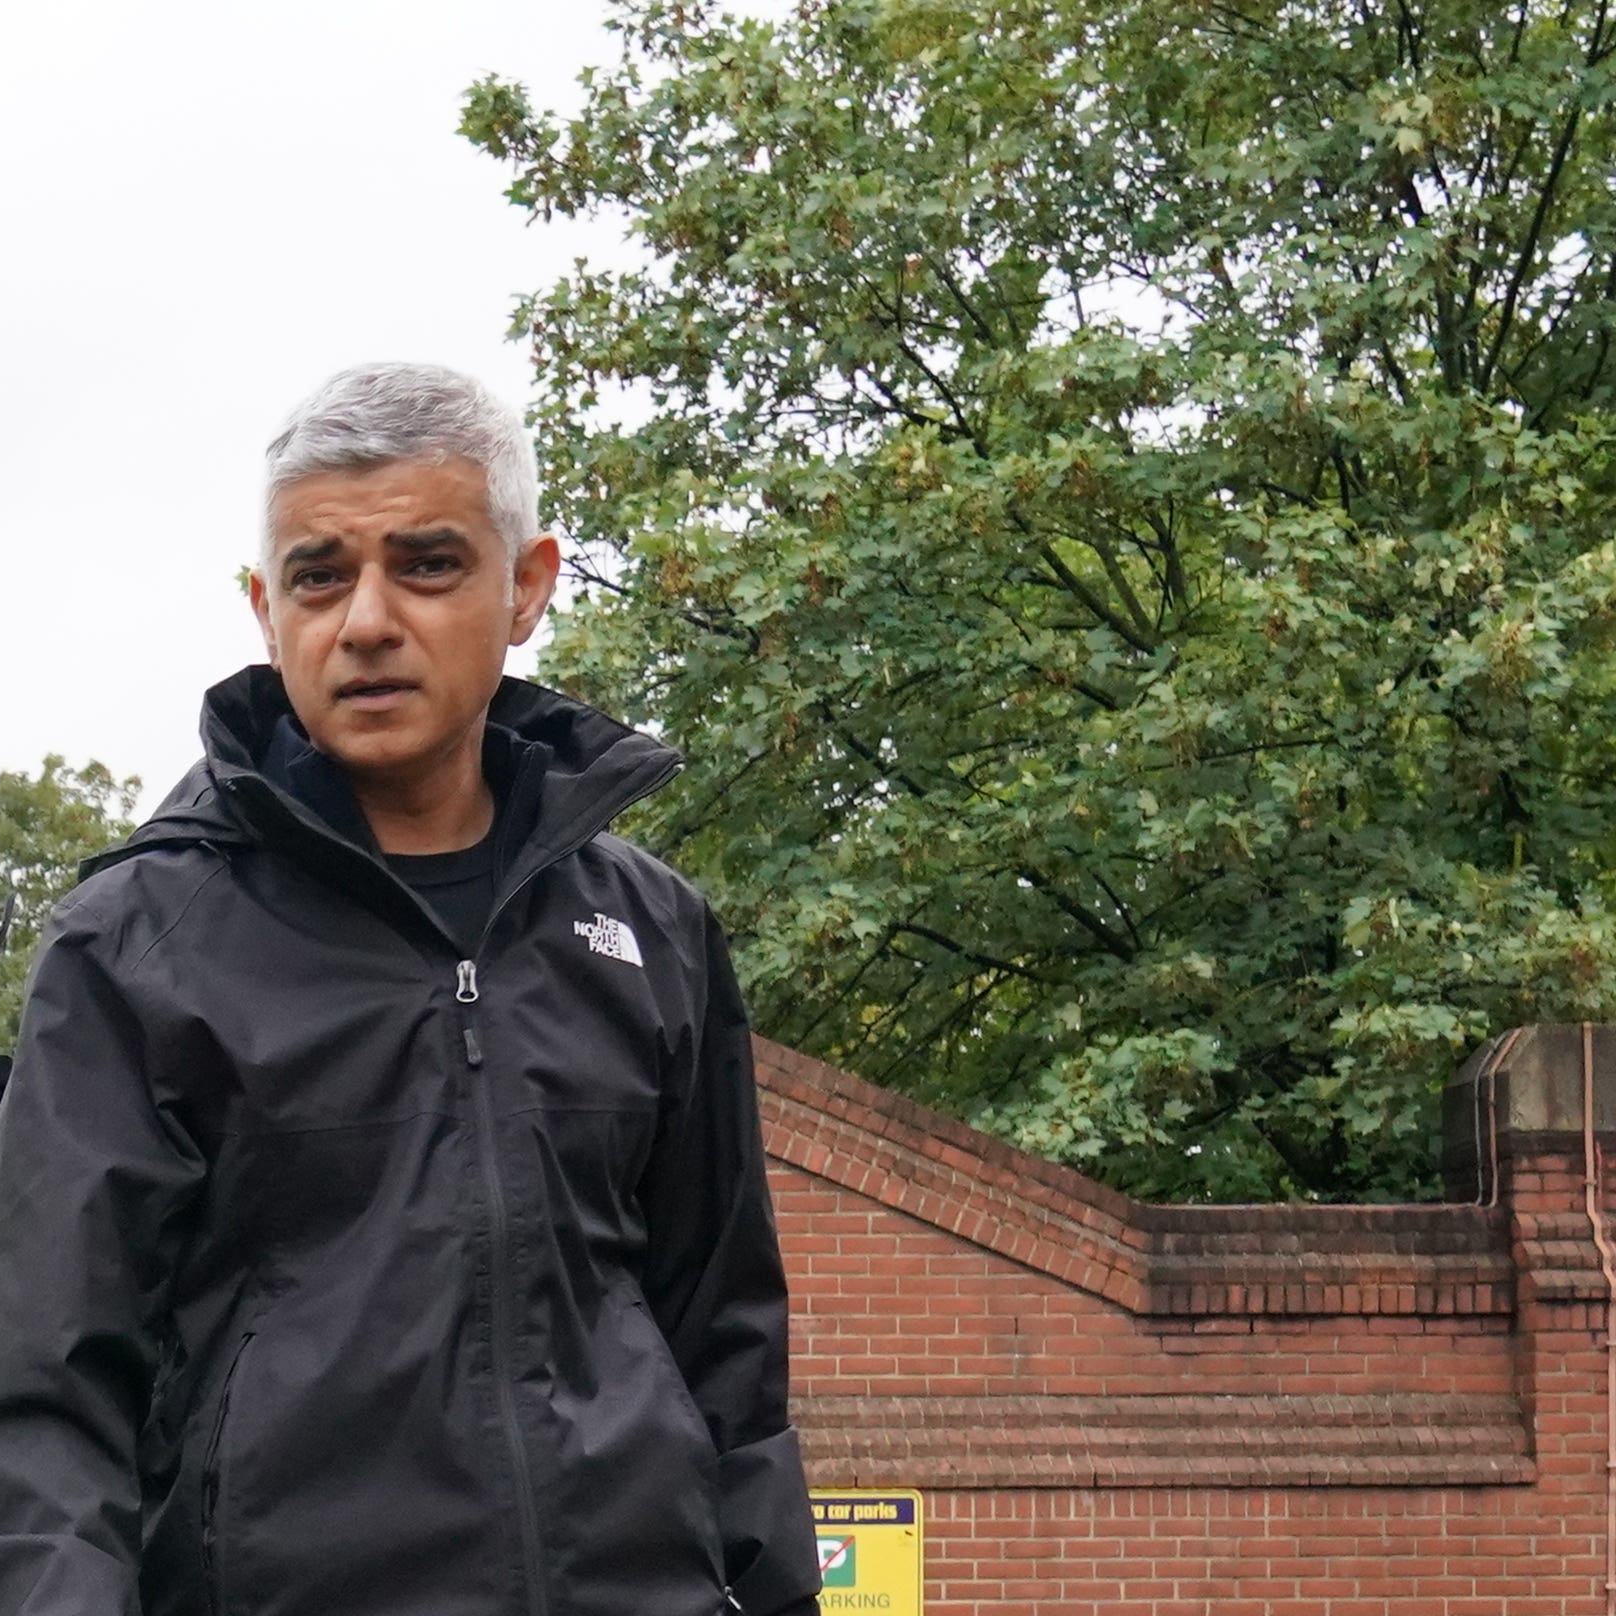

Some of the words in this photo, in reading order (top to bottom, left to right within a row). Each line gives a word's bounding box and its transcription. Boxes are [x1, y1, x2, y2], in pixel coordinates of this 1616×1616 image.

[594, 912, 618, 931] THE
[573, 920, 620, 947] NORTH
[590, 936, 621, 960] FACE
[828, 1504, 852, 1520] car
[853, 1502, 897, 1521] parks
[819, 1593, 891, 1609] ARKING
